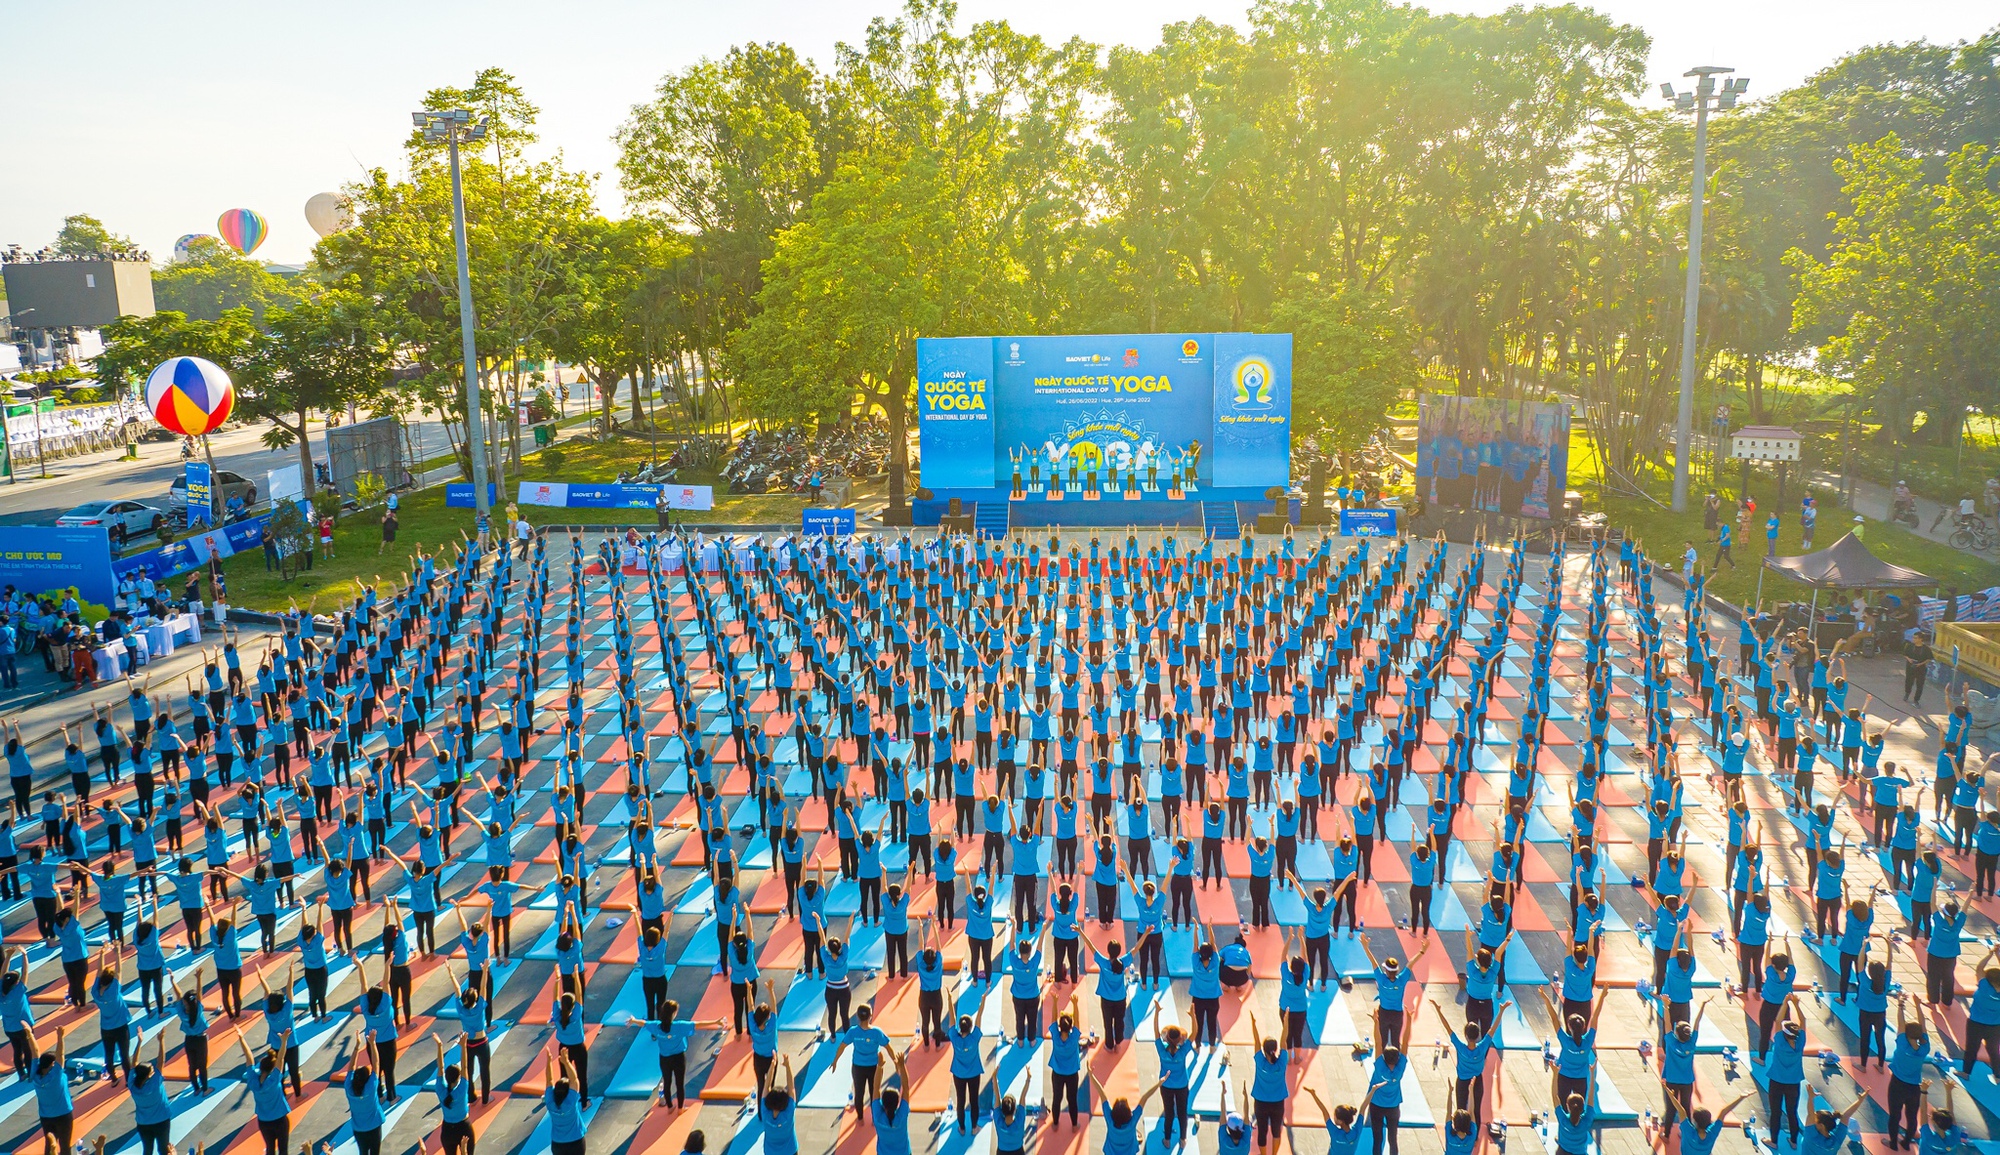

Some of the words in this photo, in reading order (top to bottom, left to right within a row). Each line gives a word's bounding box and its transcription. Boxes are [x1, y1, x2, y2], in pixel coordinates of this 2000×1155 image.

[943, 370, 966, 379] NGÀY
[1034, 376, 1062, 386] NGÀY
[1064, 375, 1094, 386] QUỐC
[1096, 375, 1110, 385] TẾ
[924, 380, 966, 393] QUỐC
[969, 379, 986, 392] TẾ
[1110, 375, 1172, 393] YOGA
[925, 394, 986, 411] YOGA
[1046, 440, 1161, 471] YOGA
[187, 483, 209, 493] YOGA
